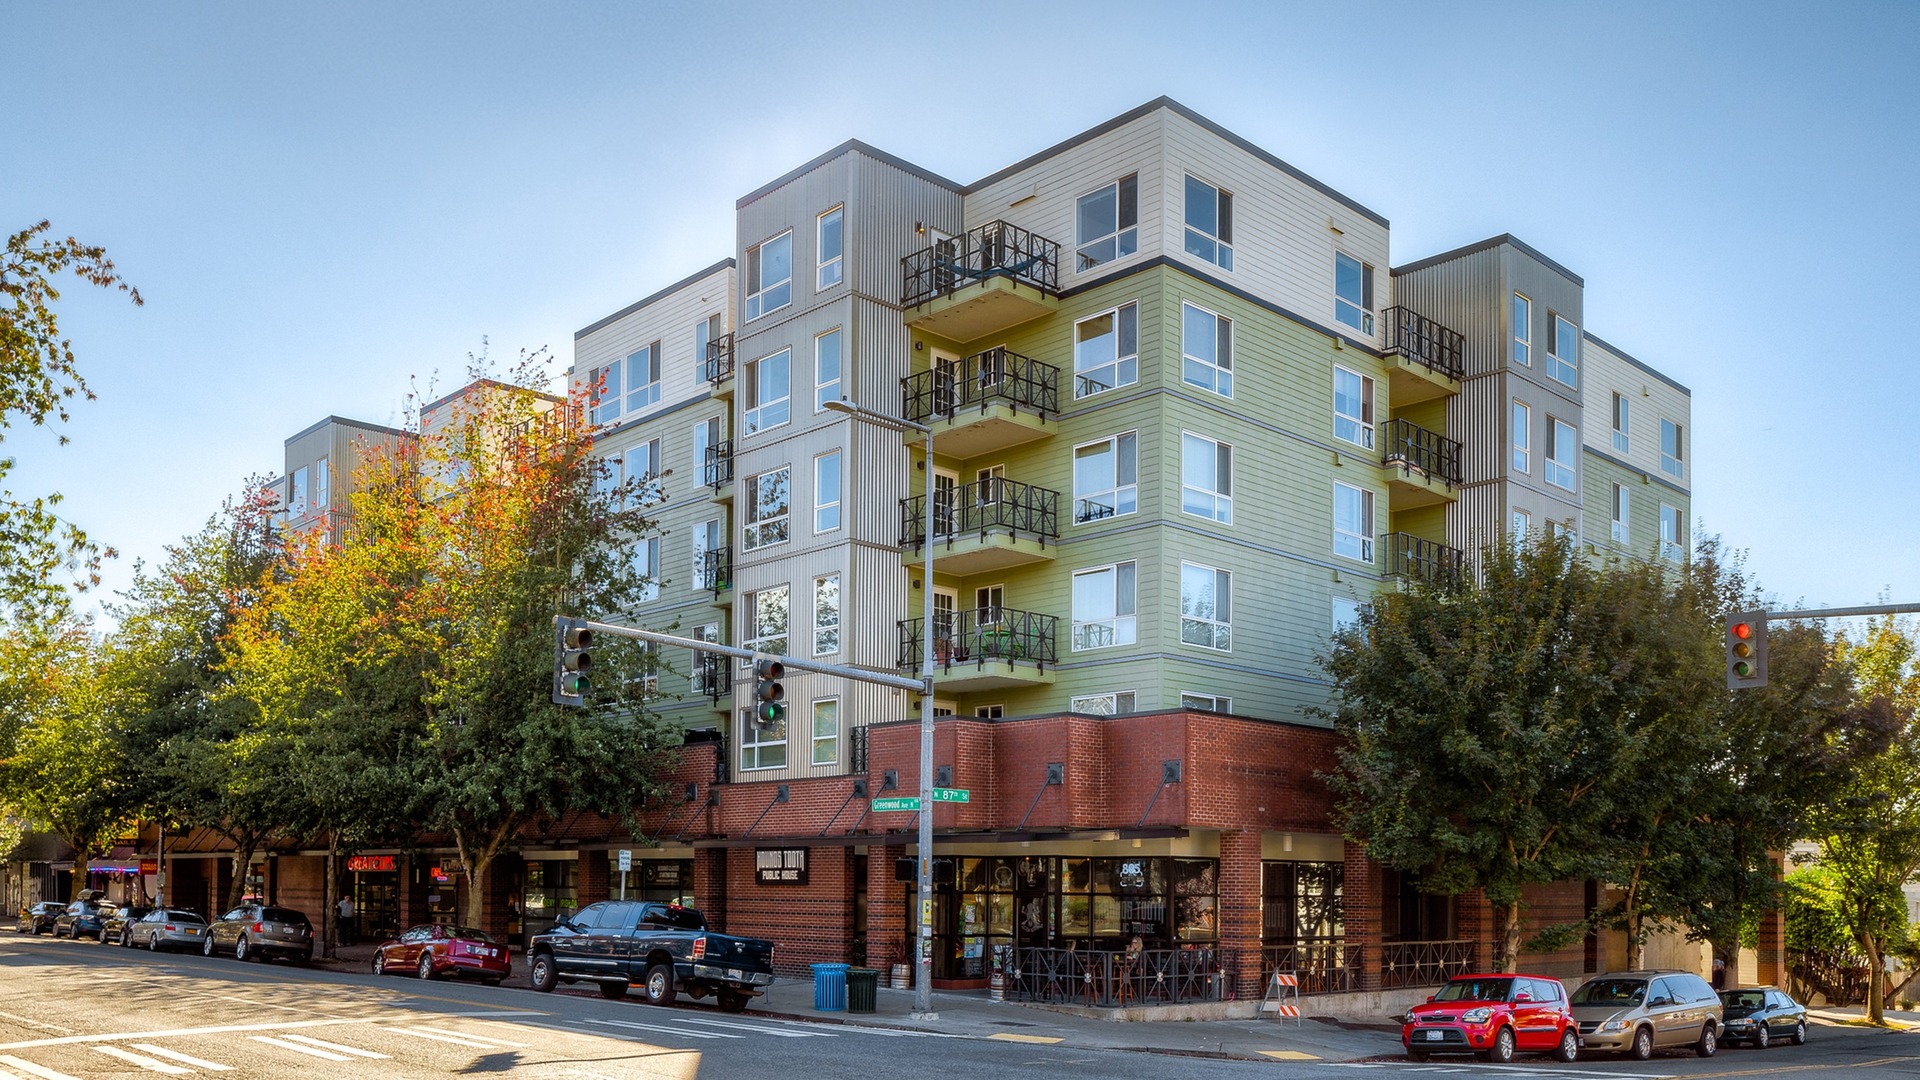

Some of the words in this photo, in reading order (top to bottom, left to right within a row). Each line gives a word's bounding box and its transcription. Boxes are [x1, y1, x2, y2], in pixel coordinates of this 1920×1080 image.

[942, 790, 958, 800] 87th
[874, 800, 900, 810] Greenwood
[347, 855, 372, 871] GREAT
[783, 850, 805, 871] TOOTH
[762, 870, 780, 880] PUBLIC
[781, 870, 799, 880] HOUSE
